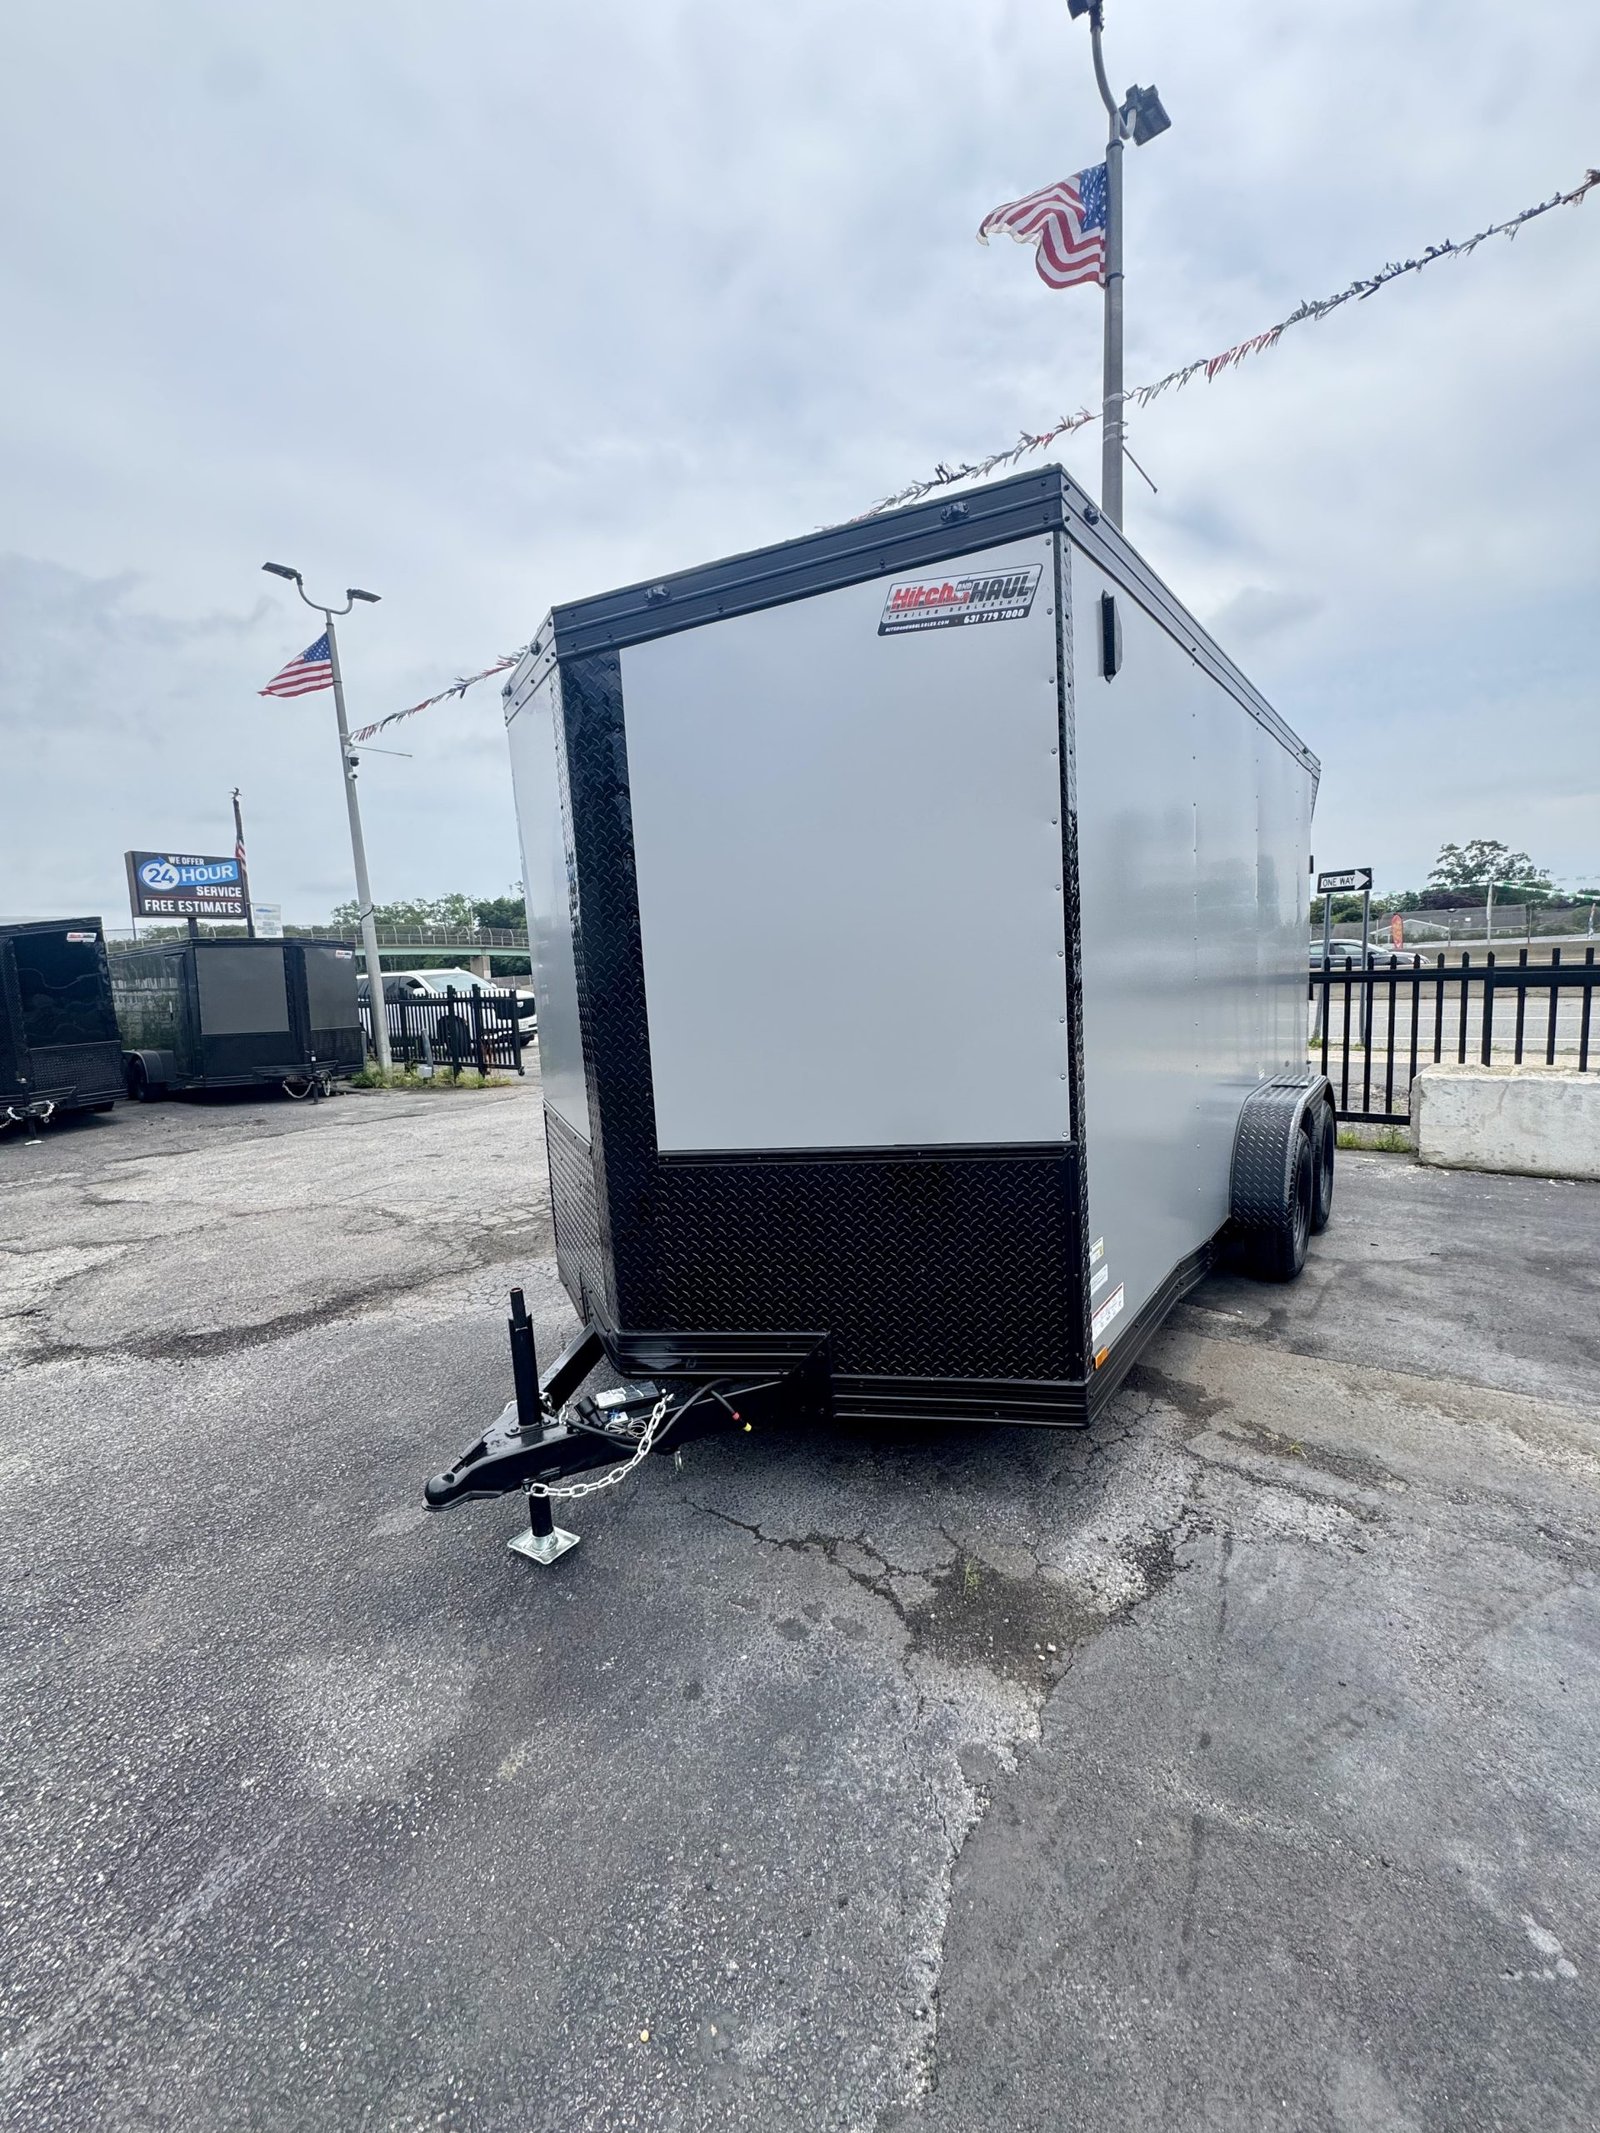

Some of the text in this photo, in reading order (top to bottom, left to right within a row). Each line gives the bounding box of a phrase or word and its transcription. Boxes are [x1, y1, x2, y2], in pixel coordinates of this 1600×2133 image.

[892, 582, 955, 609] Hitch
[969, 575, 1030, 603] HAUL
[964, 614, 980, 624] 631
[982, 611, 999, 622] 779
[1001, 608, 1025, 620] 7000
[168, 856, 205, 866] WE OFFER
[148, 866, 234, 884] 24 HOUR
[1322, 876, 1355, 887] ONE WAY
[196, 885, 242, 898] SERVICE
[144, 899, 175, 912] FREE
[178, 900, 242, 914] ESTIMATES
